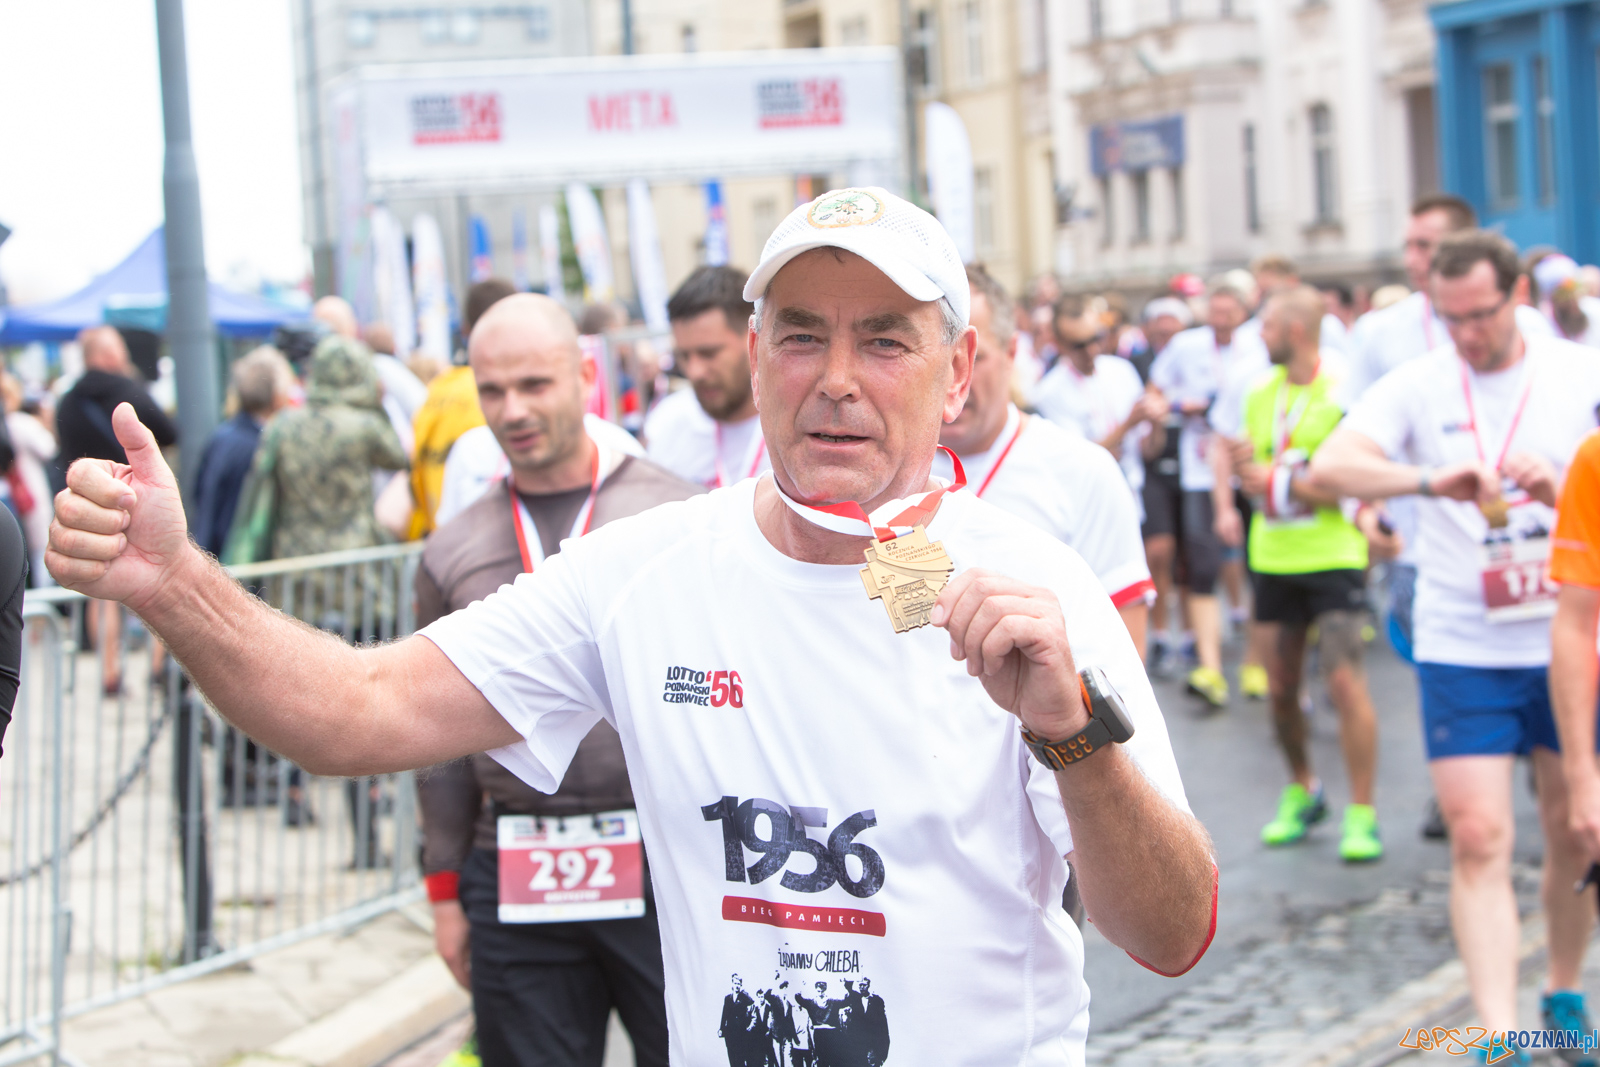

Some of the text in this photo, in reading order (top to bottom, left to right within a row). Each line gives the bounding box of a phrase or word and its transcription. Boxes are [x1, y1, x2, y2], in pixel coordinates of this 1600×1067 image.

[587, 92, 678, 132] META
[885, 542, 899, 552] 62
[888, 545, 915, 556] ROCZNICA
[905, 551, 930, 561] CZERWCA
[666, 666, 705, 684] LOTTO
[664, 682, 710, 695] POZNAŃSKI
[662, 692, 709, 706] CZERWIEC
[700, 795, 886, 899] 1956
[528, 847, 616, 891] 292
[741, 904, 865, 926] BIEG PAMIĘCI
[815, 950, 860, 973] CHLEBA
